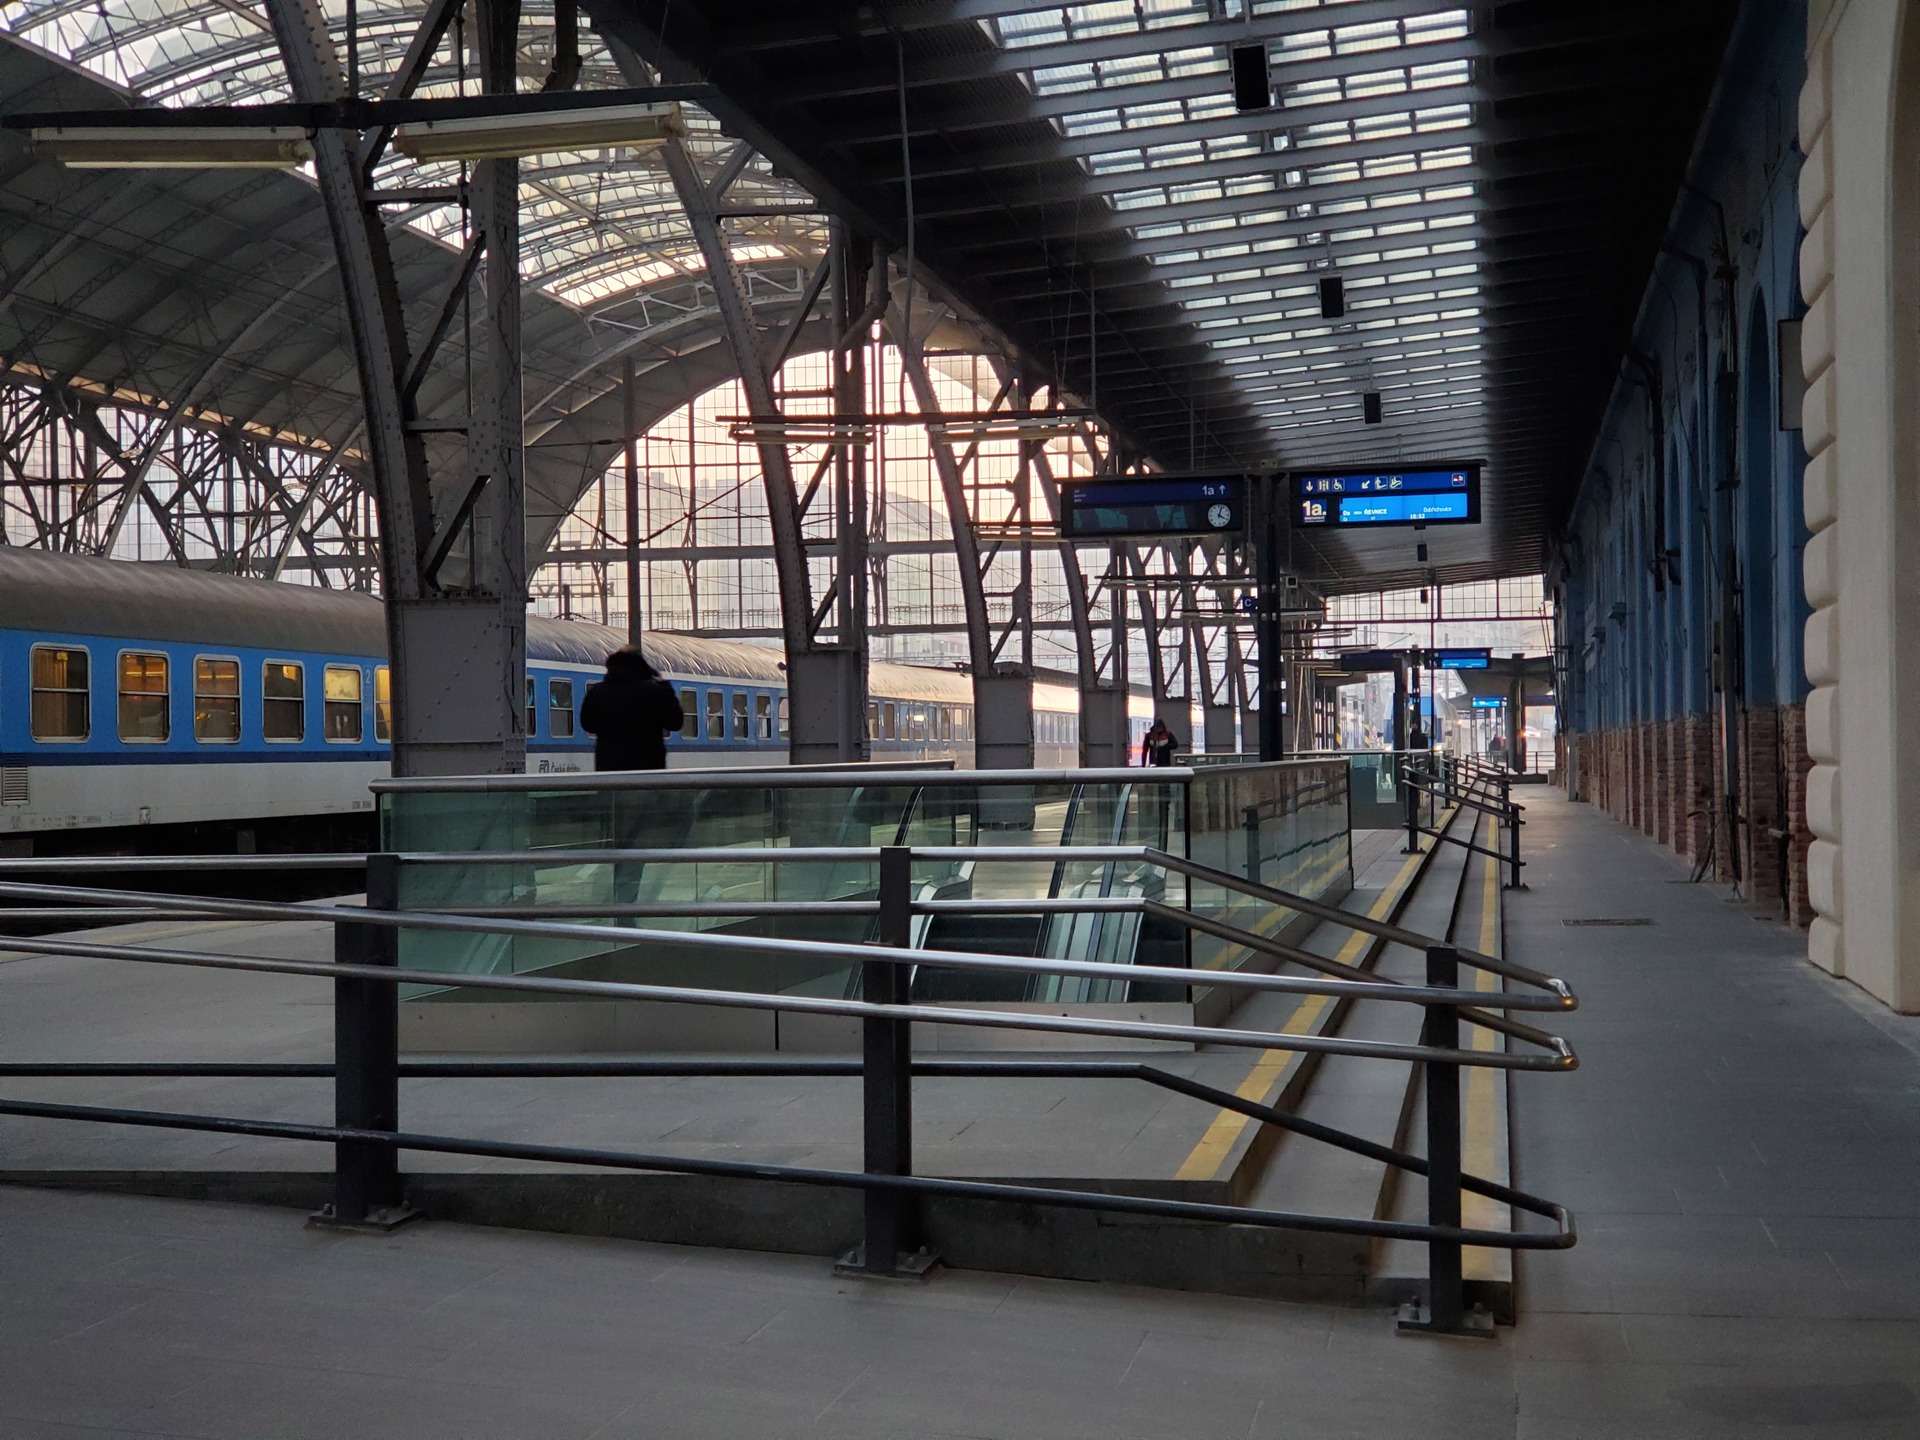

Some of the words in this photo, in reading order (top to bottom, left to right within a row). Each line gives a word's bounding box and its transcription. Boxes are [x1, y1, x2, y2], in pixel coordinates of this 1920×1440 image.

[1202, 484, 1215, 496] 1a
[1244, 598, 1252, 607] C
[366, 669, 371, 684] 2
